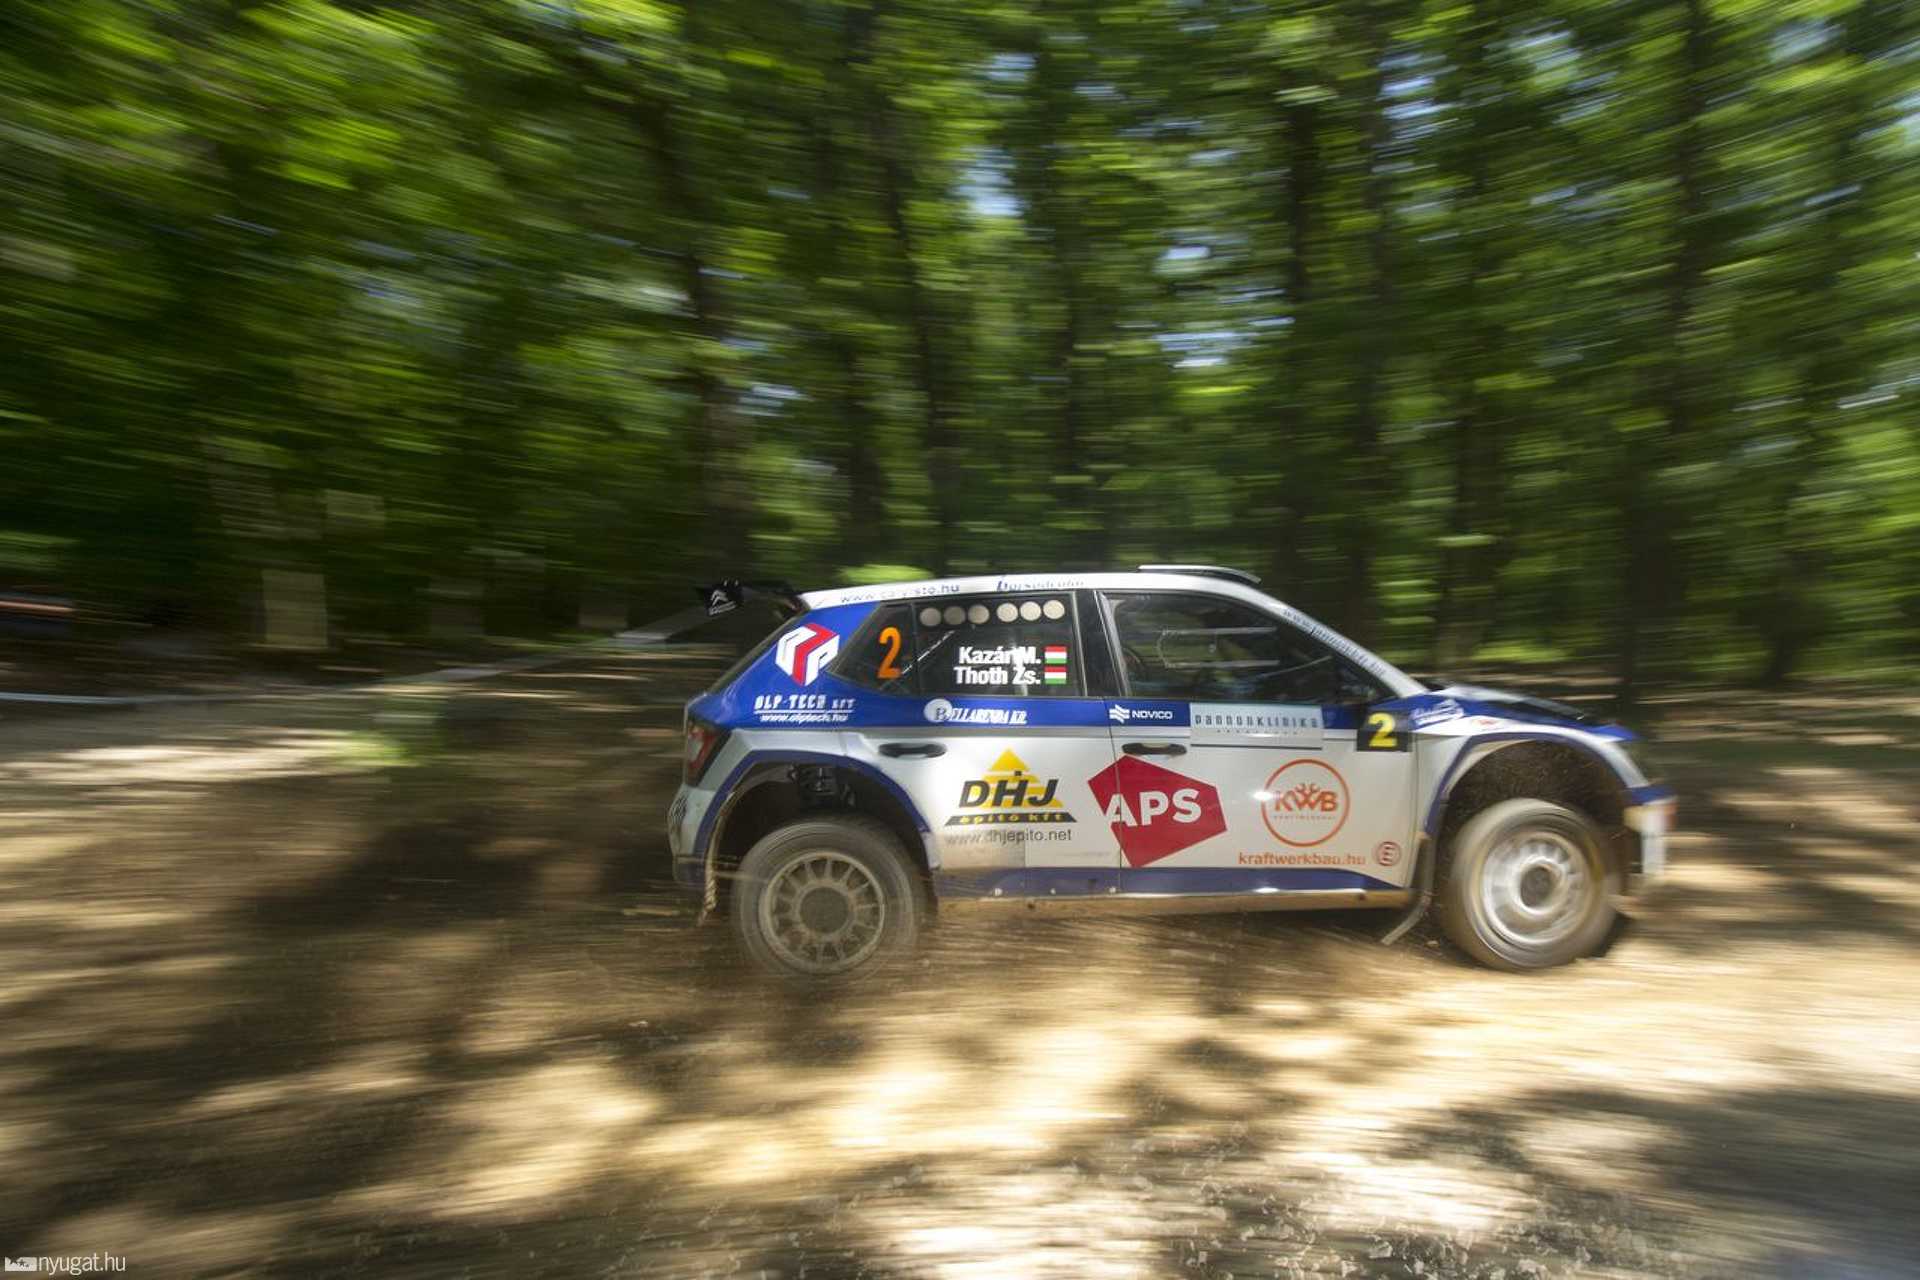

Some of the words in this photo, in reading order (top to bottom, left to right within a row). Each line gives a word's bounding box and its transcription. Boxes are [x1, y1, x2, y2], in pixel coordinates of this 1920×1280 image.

[877, 626, 901, 679] 2
[953, 666, 1008, 684] Thoth
[1132, 709, 1174, 720] NOVICO
[1368, 711, 1397, 748] 2
[959, 778, 1060, 808] DHJ
[1274, 788, 1338, 812] KWB
[1104, 788, 1202, 827] APS
[944, 829, 1072, 846] www.dhjepito.net
[1238, 852, 1366, 865] kraftwerkbau.hu
